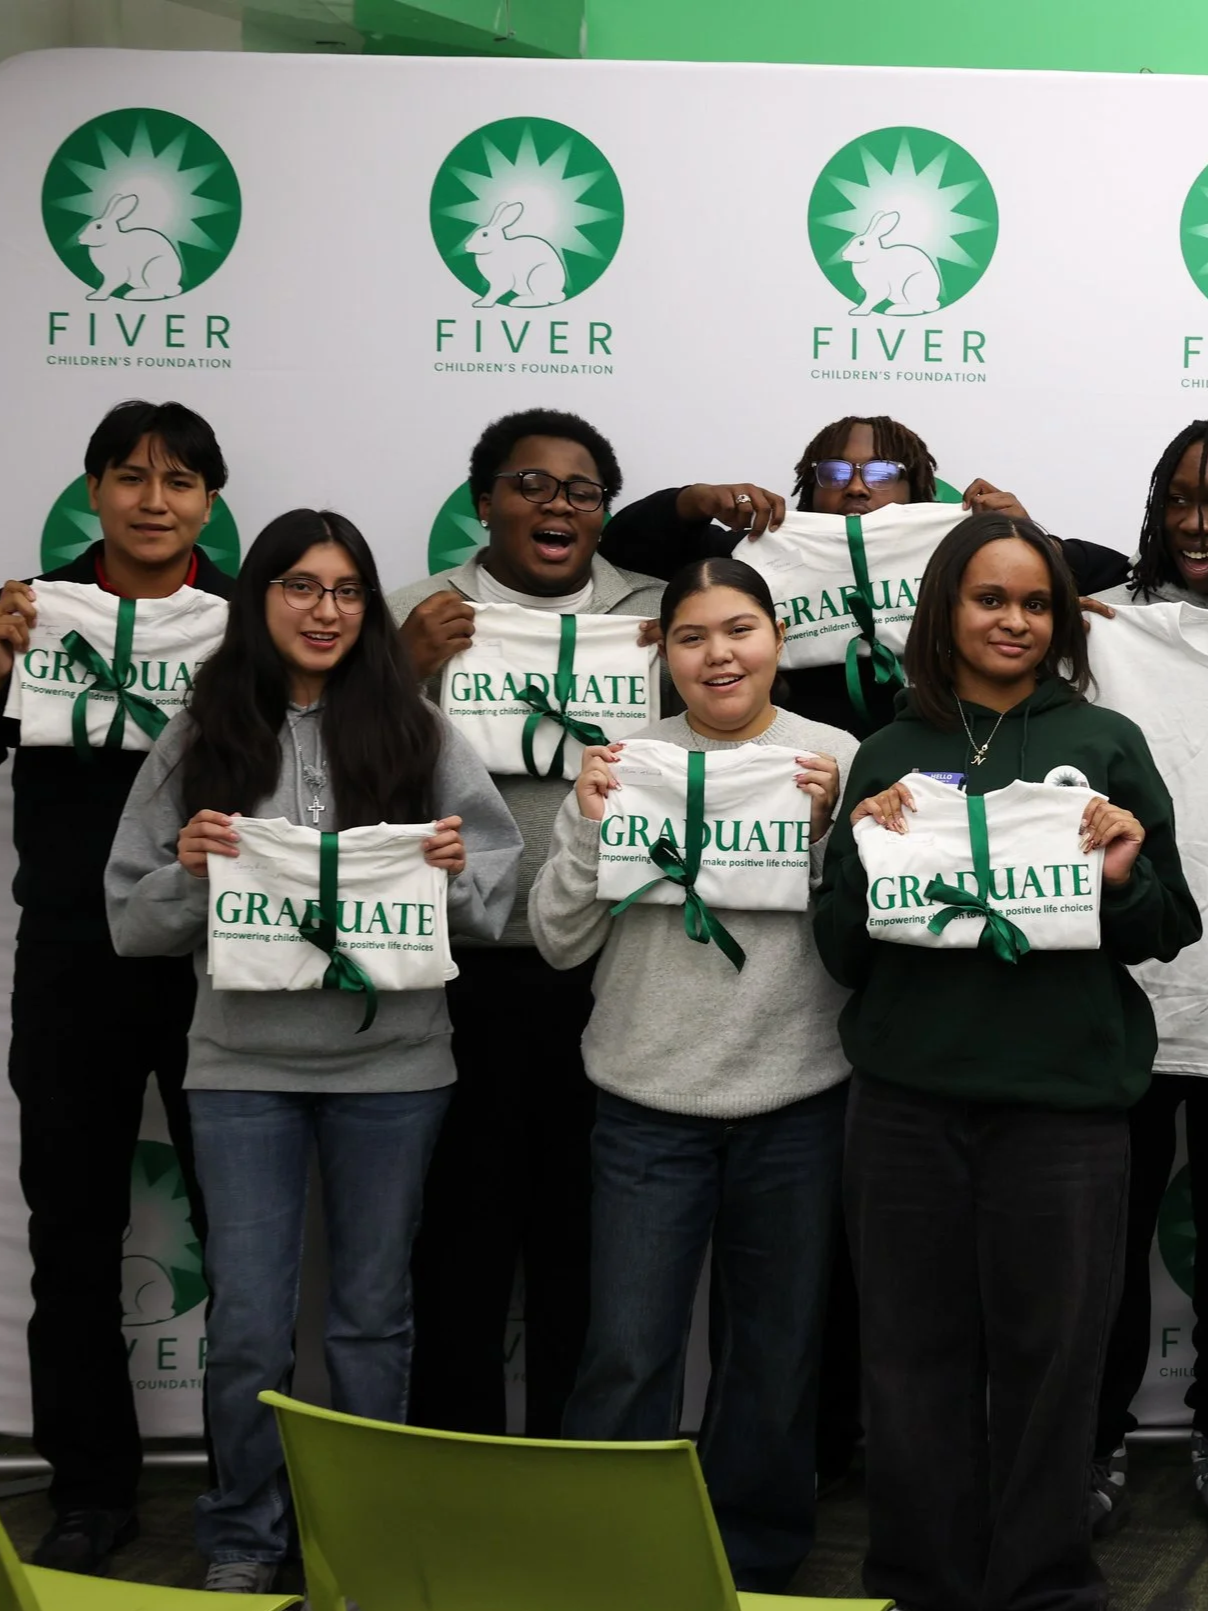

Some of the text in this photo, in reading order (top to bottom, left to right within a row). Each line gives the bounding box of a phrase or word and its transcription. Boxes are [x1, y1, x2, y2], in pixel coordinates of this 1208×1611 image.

[48, 311, 231, 349] FIVER
[436, 319, 613, 355] FIVER
[812, 326, 986, 363] FIVER
[46, 355, 231, 369] CHILDREN'S FOUNDATION
[433, 362, 613, 375] CHILDREN'S FOUNDATION
[810, 369, 986, 382] CHILDREN'S FOUNDATION
[783, 627, 819, 642] powering
[820, 621, 850, 635] children
[21, 681, 76, 699] Empowering
[448, 707, 498, 717] Empowering
[567, 709, 600, 718] positive
[601, 710, 615, 718] life
[616, 711, 647, 719] choices
[930, 773, 953, 781] HELLO
[702, 858, 728, 867] make
[728, 858, 764, 868] positive
[766, 859, 780, 868] life
[869, 915, 926, 927] Empowering
[1005, 905, 1042, 917] positive
[1043, 904, 1058, 913] life
[1059, 903, 1094, 913] choices
[212, 929, 271, 943] Empowering
[272, 932, 308, 943] childre
[350, 940, 386, 951] positive
[387, 941, 402, 950] life
[402, 942, 435, 952] choices
[131, 1379, 203, 1390] OUNDATI
